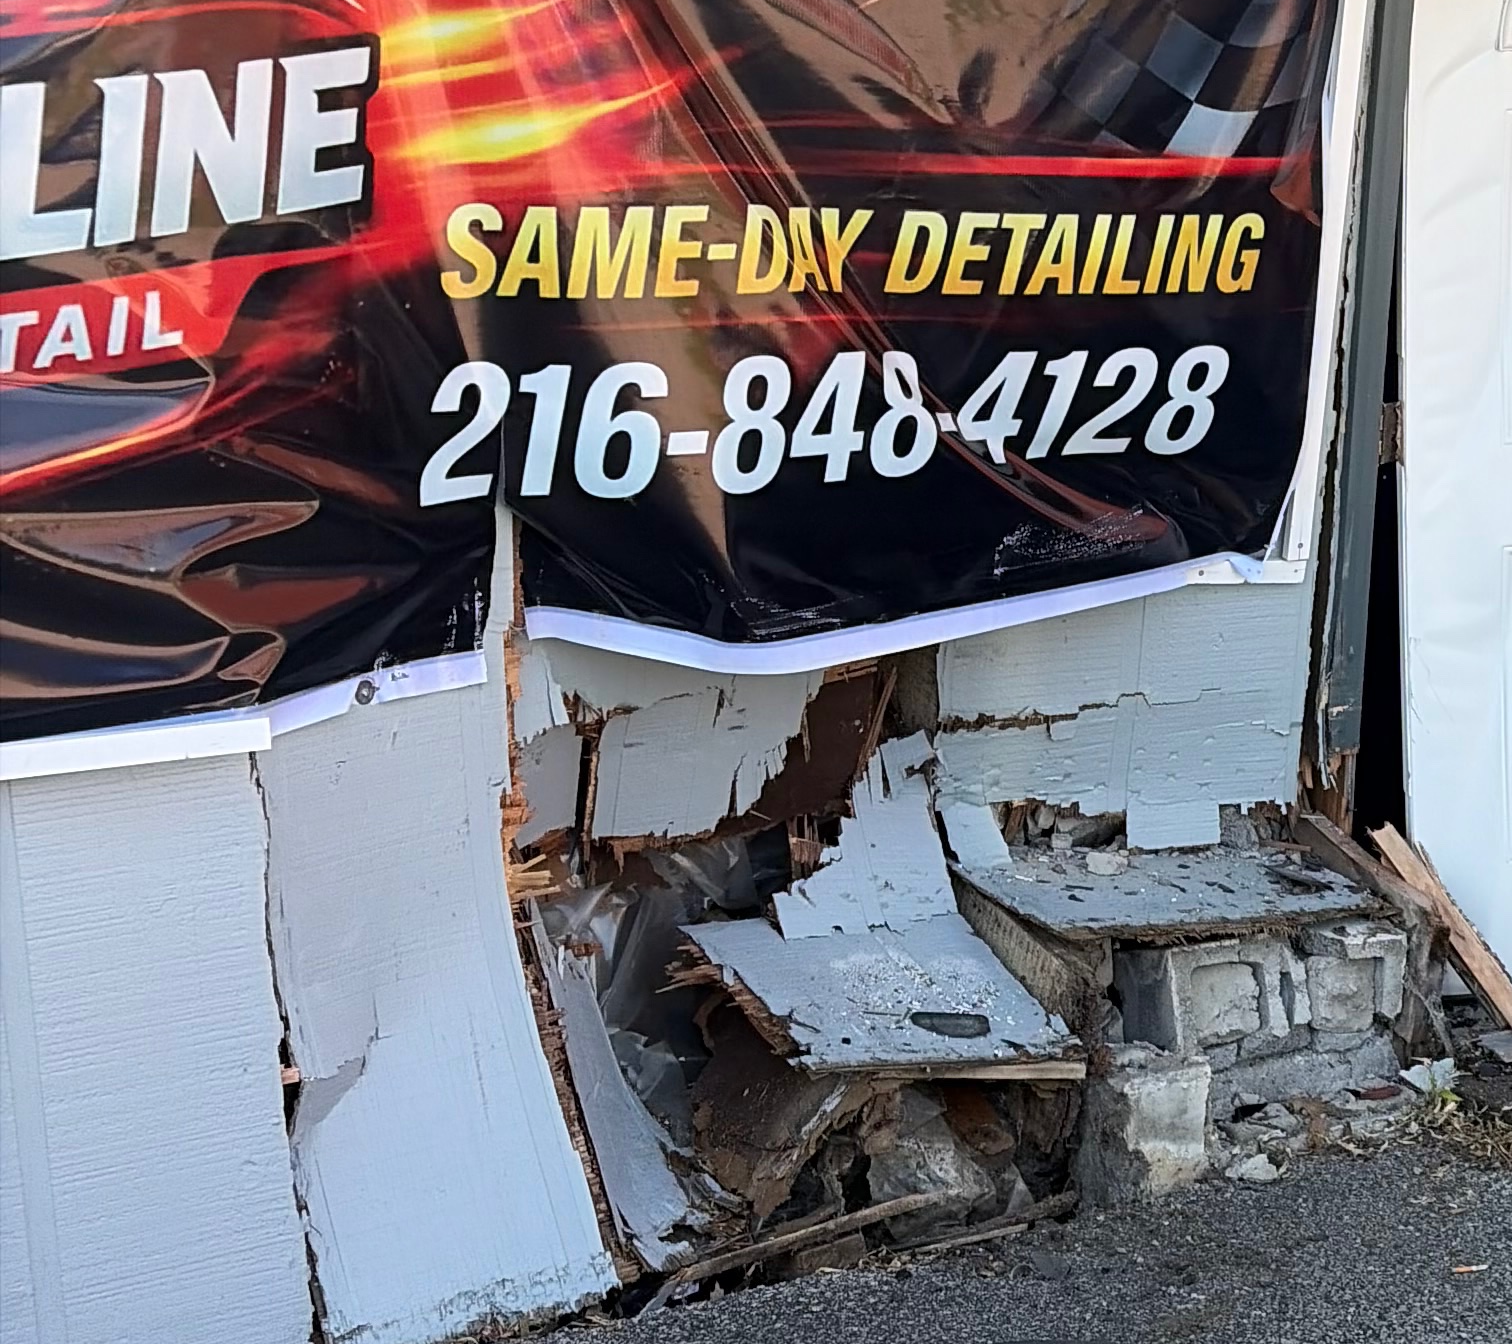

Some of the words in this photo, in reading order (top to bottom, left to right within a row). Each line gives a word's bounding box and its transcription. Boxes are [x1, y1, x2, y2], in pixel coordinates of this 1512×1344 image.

[0, 46, 371, 260] LINE
[441, 202, 873, 299] SAME-DAY
[884, 211, 1265, 296] DETAILING
[419, 345, 1230, 507] 216-848-4128
